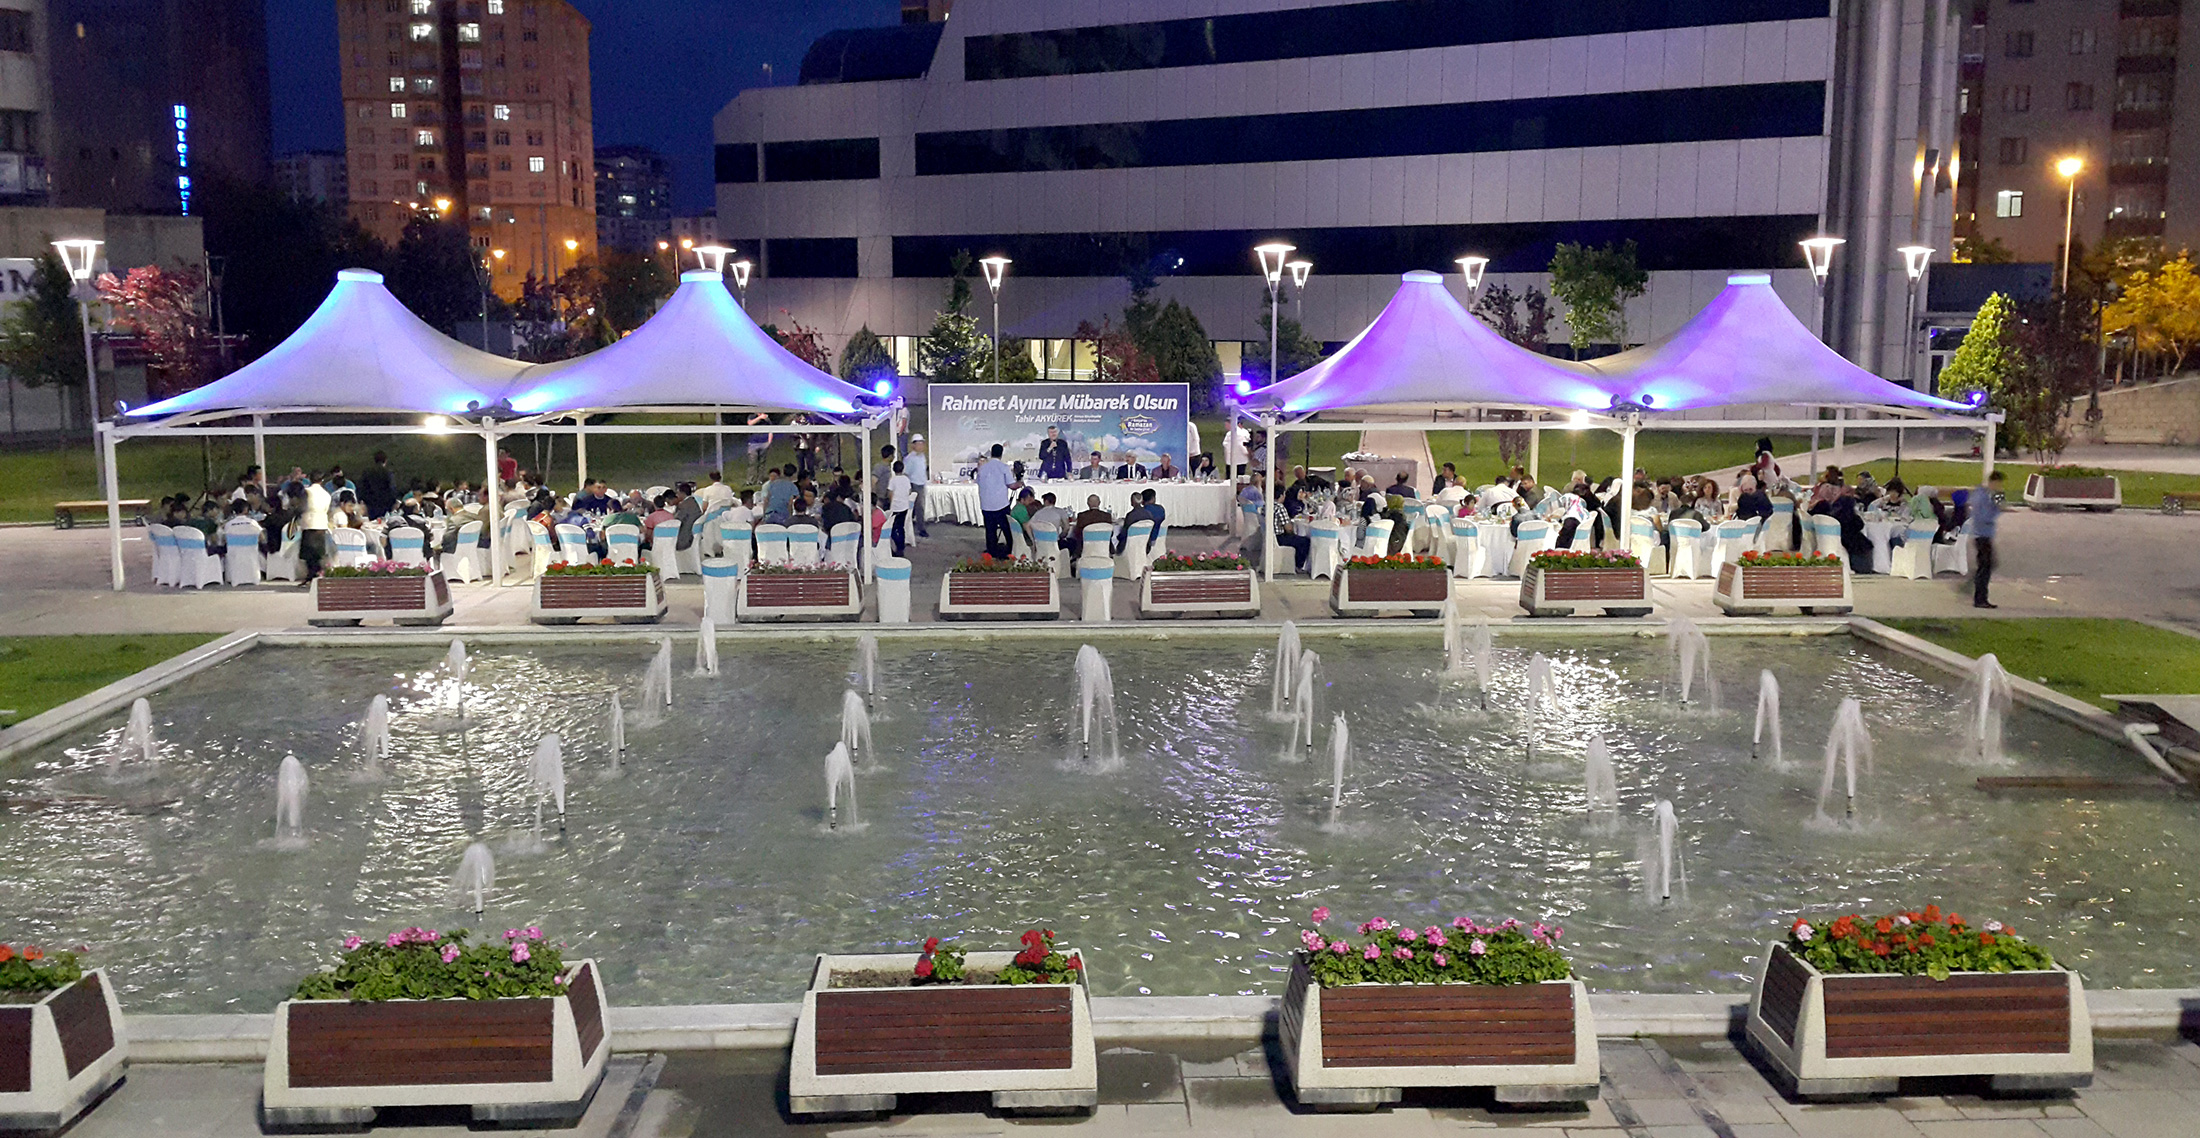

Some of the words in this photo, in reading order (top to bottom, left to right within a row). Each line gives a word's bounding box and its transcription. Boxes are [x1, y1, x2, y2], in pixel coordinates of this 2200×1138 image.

[173, 104, 187, 168] Hotel
[941, 394, 1006, 411] Rahmet
[1006, 394, 1057, 414] Ayınız
[1059, 393, 1130, 410] Mübarek
[1132, 394, 1178, 410] Olsun
[1014, 414, 1035, 423] Tahir
[1034, 412, 1073, 423] AKYÜREK
